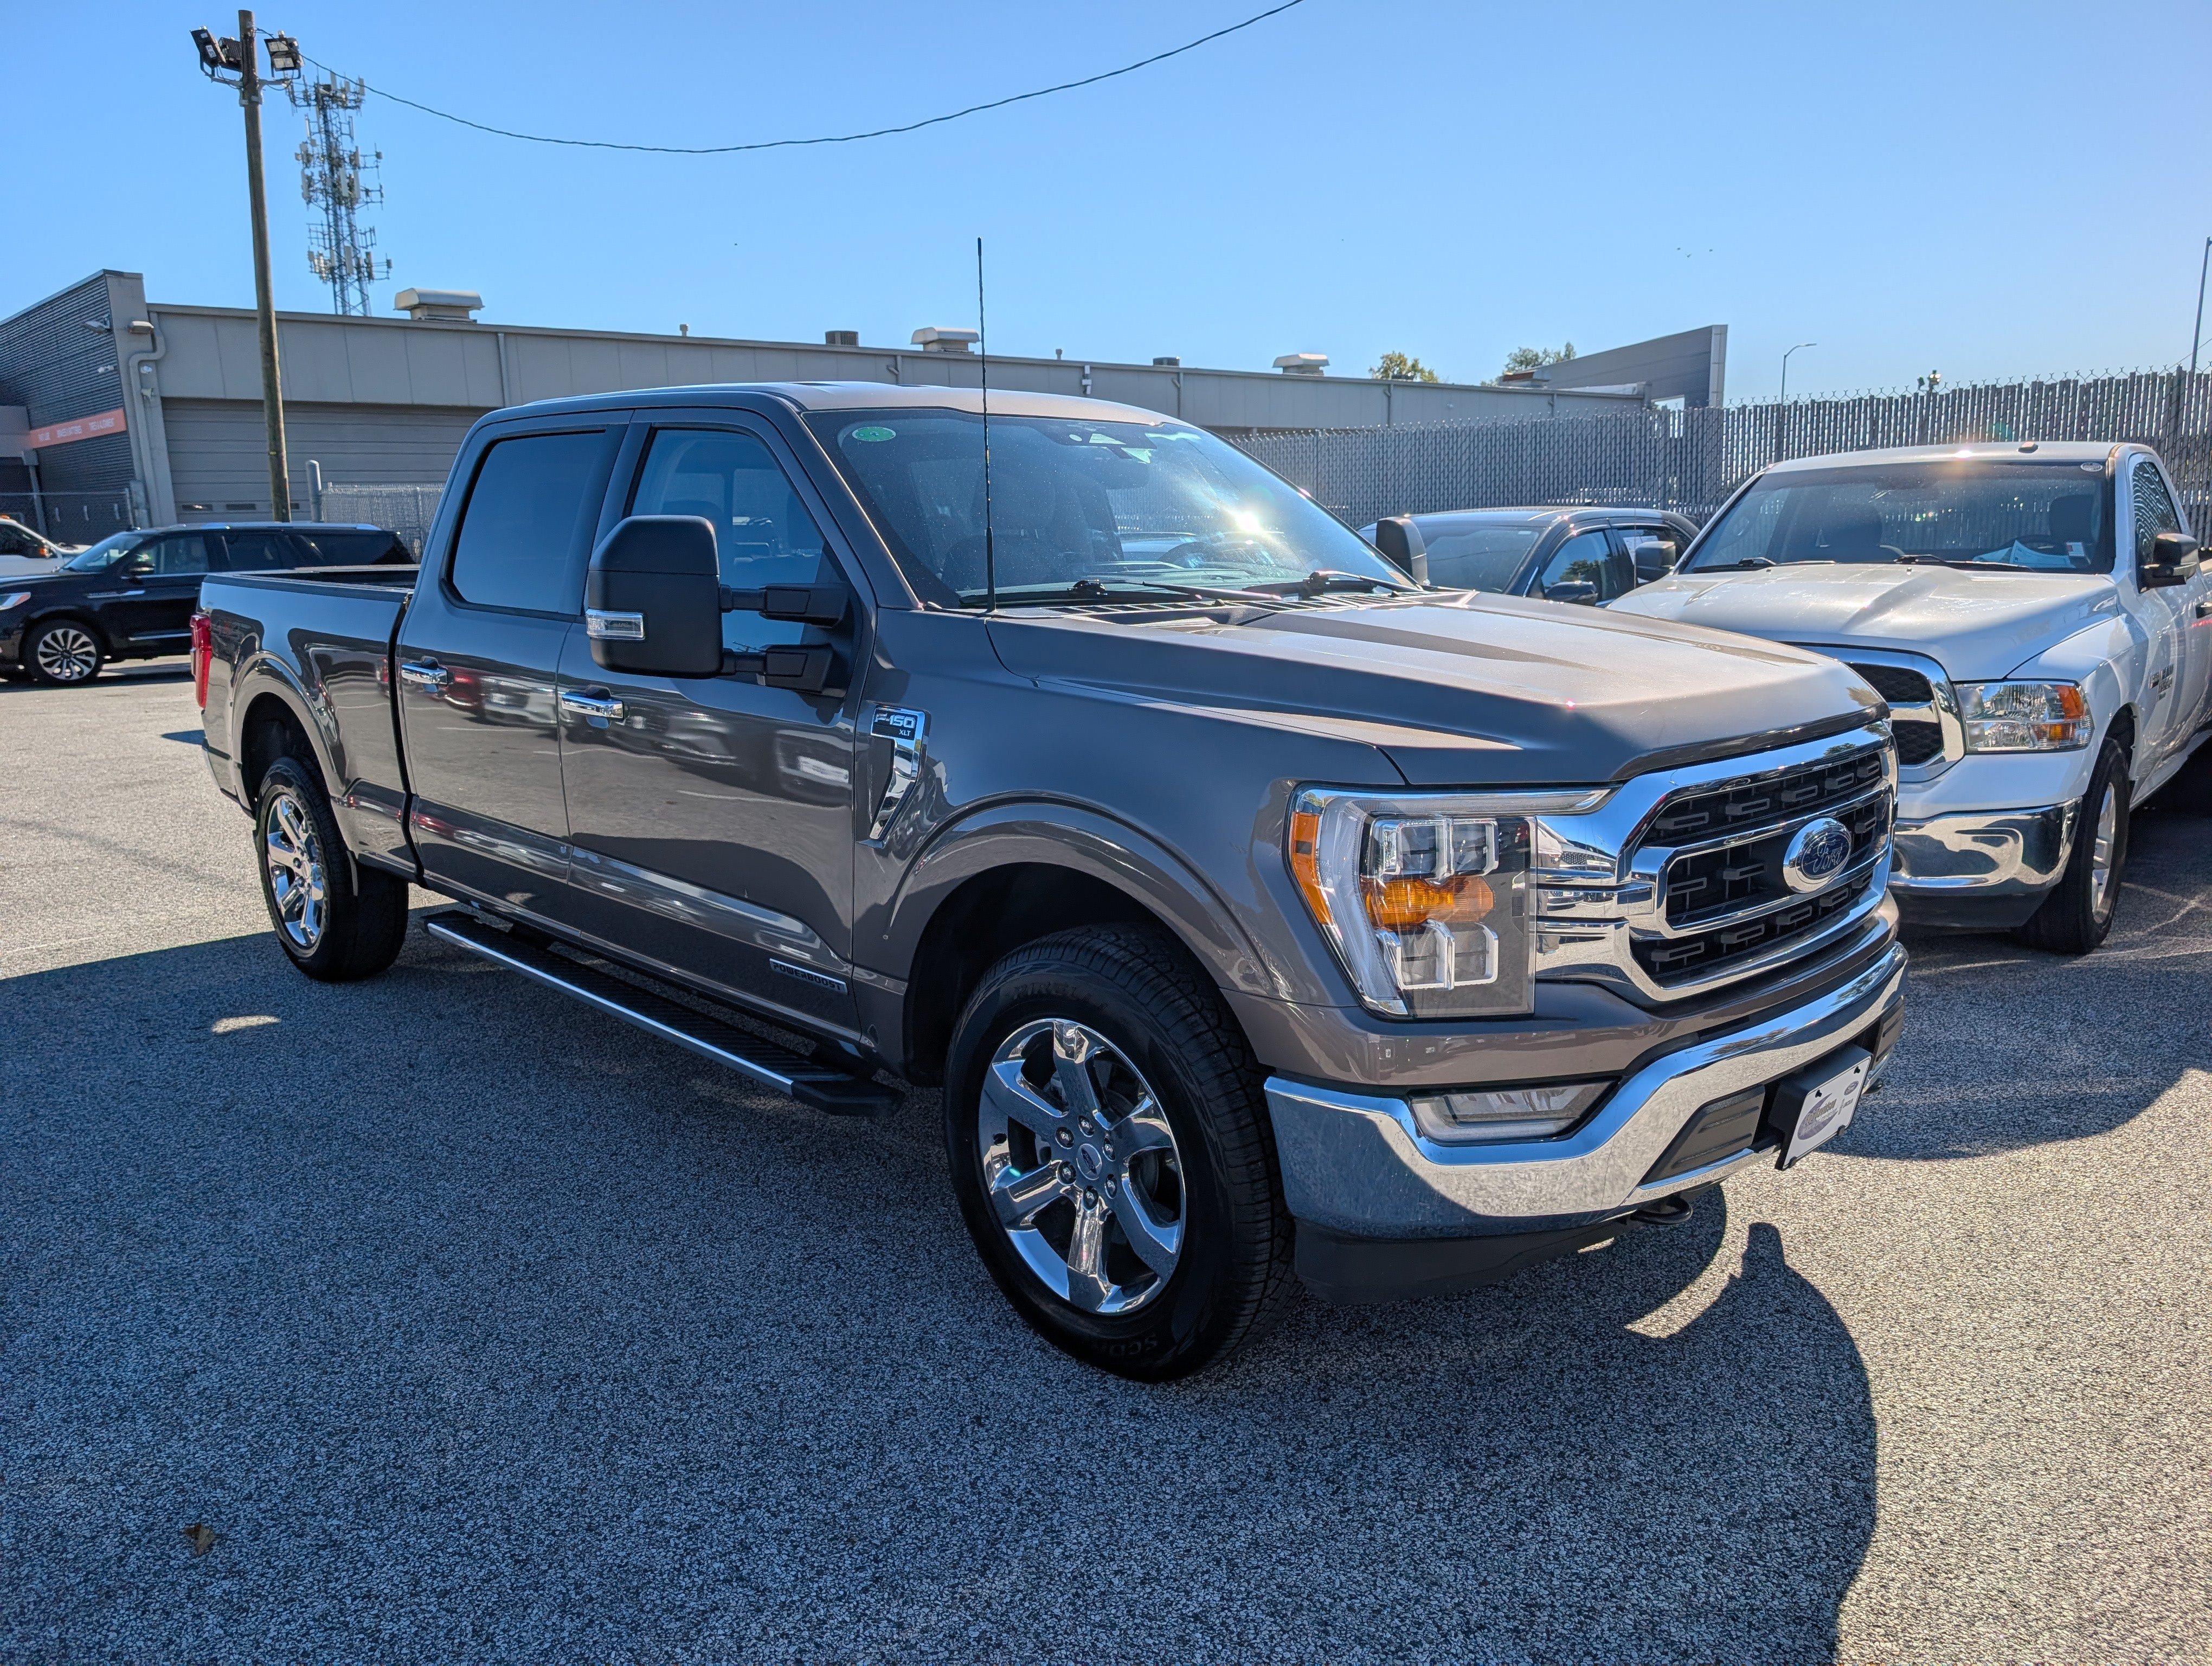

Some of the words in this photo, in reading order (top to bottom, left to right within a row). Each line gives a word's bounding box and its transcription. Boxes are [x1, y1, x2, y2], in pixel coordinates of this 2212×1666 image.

[874, 713, 916, 729] F-150
[1812, 838, 1844, 873] Ford
[773, 962, 841, 991] POWERBOOST
